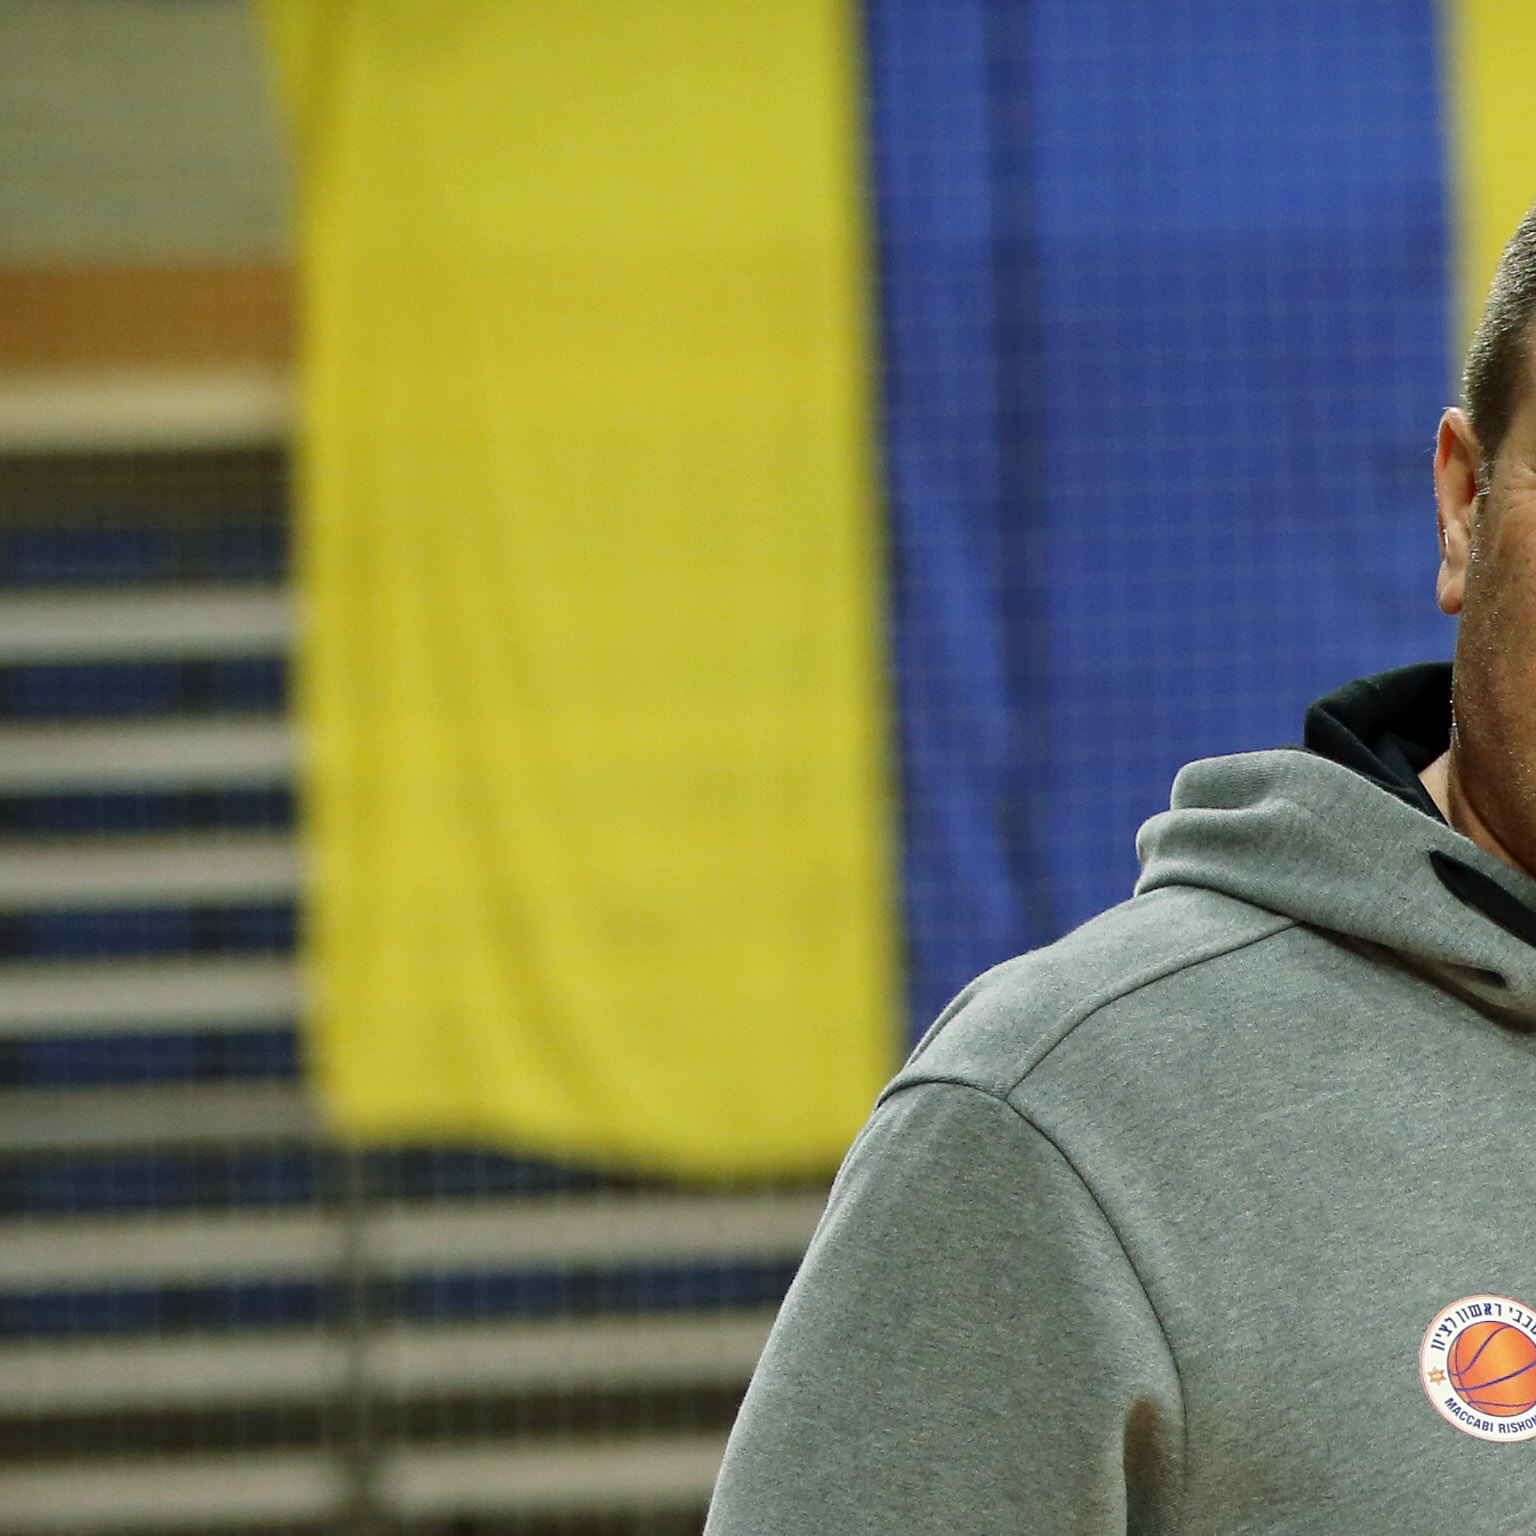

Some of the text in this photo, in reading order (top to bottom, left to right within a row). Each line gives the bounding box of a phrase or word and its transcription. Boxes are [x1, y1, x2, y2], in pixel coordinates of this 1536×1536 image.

[1455, 1303, 1501, 1323] ראשון
[1431, 1317, 1457, 1351] לציון
[1444, 1397, 1494, 1433] MACCABI
